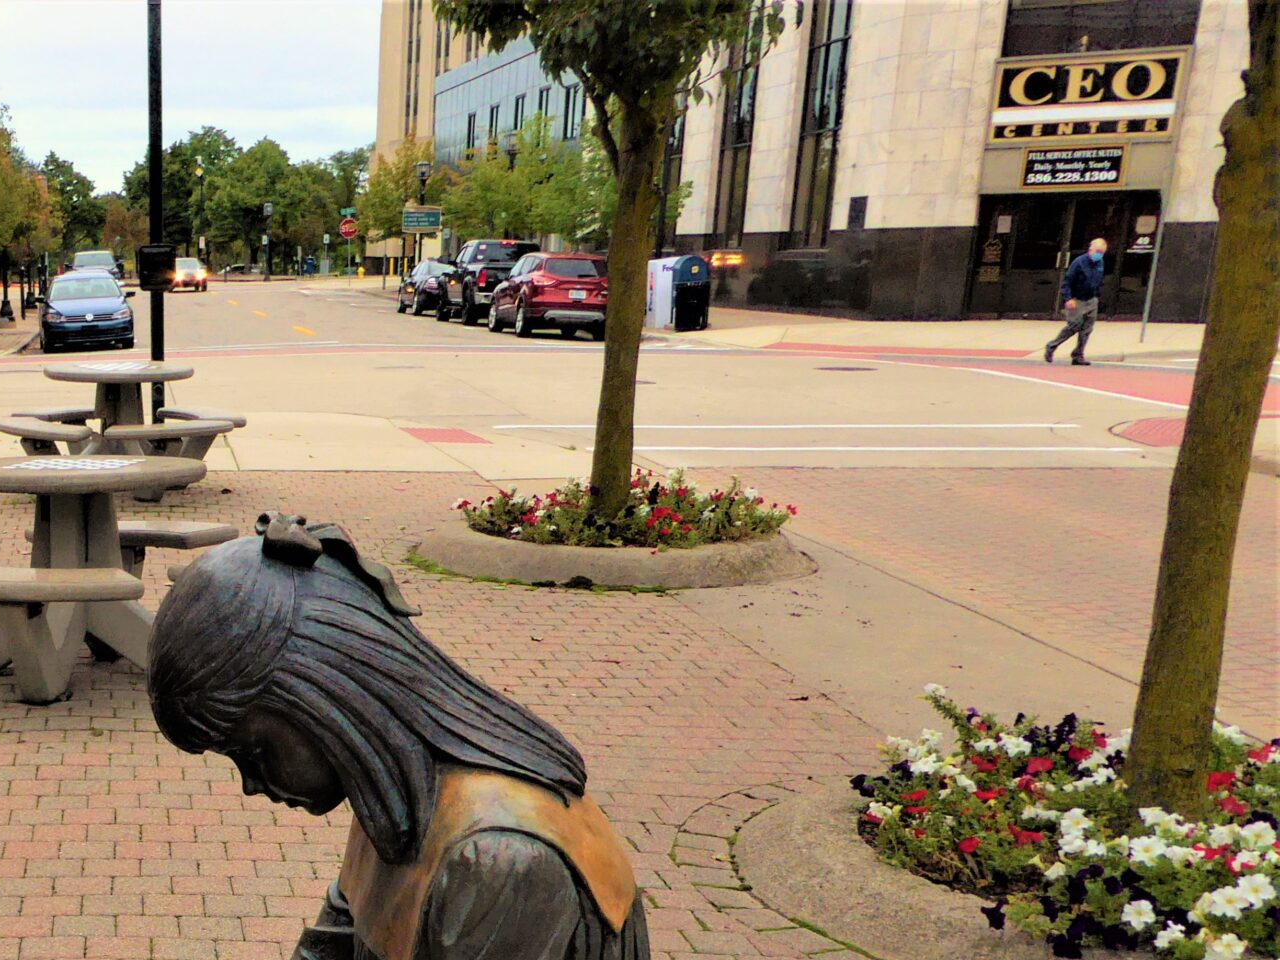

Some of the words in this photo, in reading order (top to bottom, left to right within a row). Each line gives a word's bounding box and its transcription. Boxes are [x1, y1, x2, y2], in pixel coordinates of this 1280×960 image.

[1009, 60, 1166, 106] CEO
[1003, 119, 1158, 138] CENTER
[1028, 152, 1045, 160] FULL
[1046, 151, 1073, 160] SERVICE
[1074, 150, 1098, 158] OFFICE
[1098, 149, 1122, 158] SUITES
[1033, 163, 1052, 171] Daily
[1055, 162, 1085, 170] Monthly
[1088, 160, 1111, 169] Yearly
[1026, 170, 1117, 183] 586.228.1300
